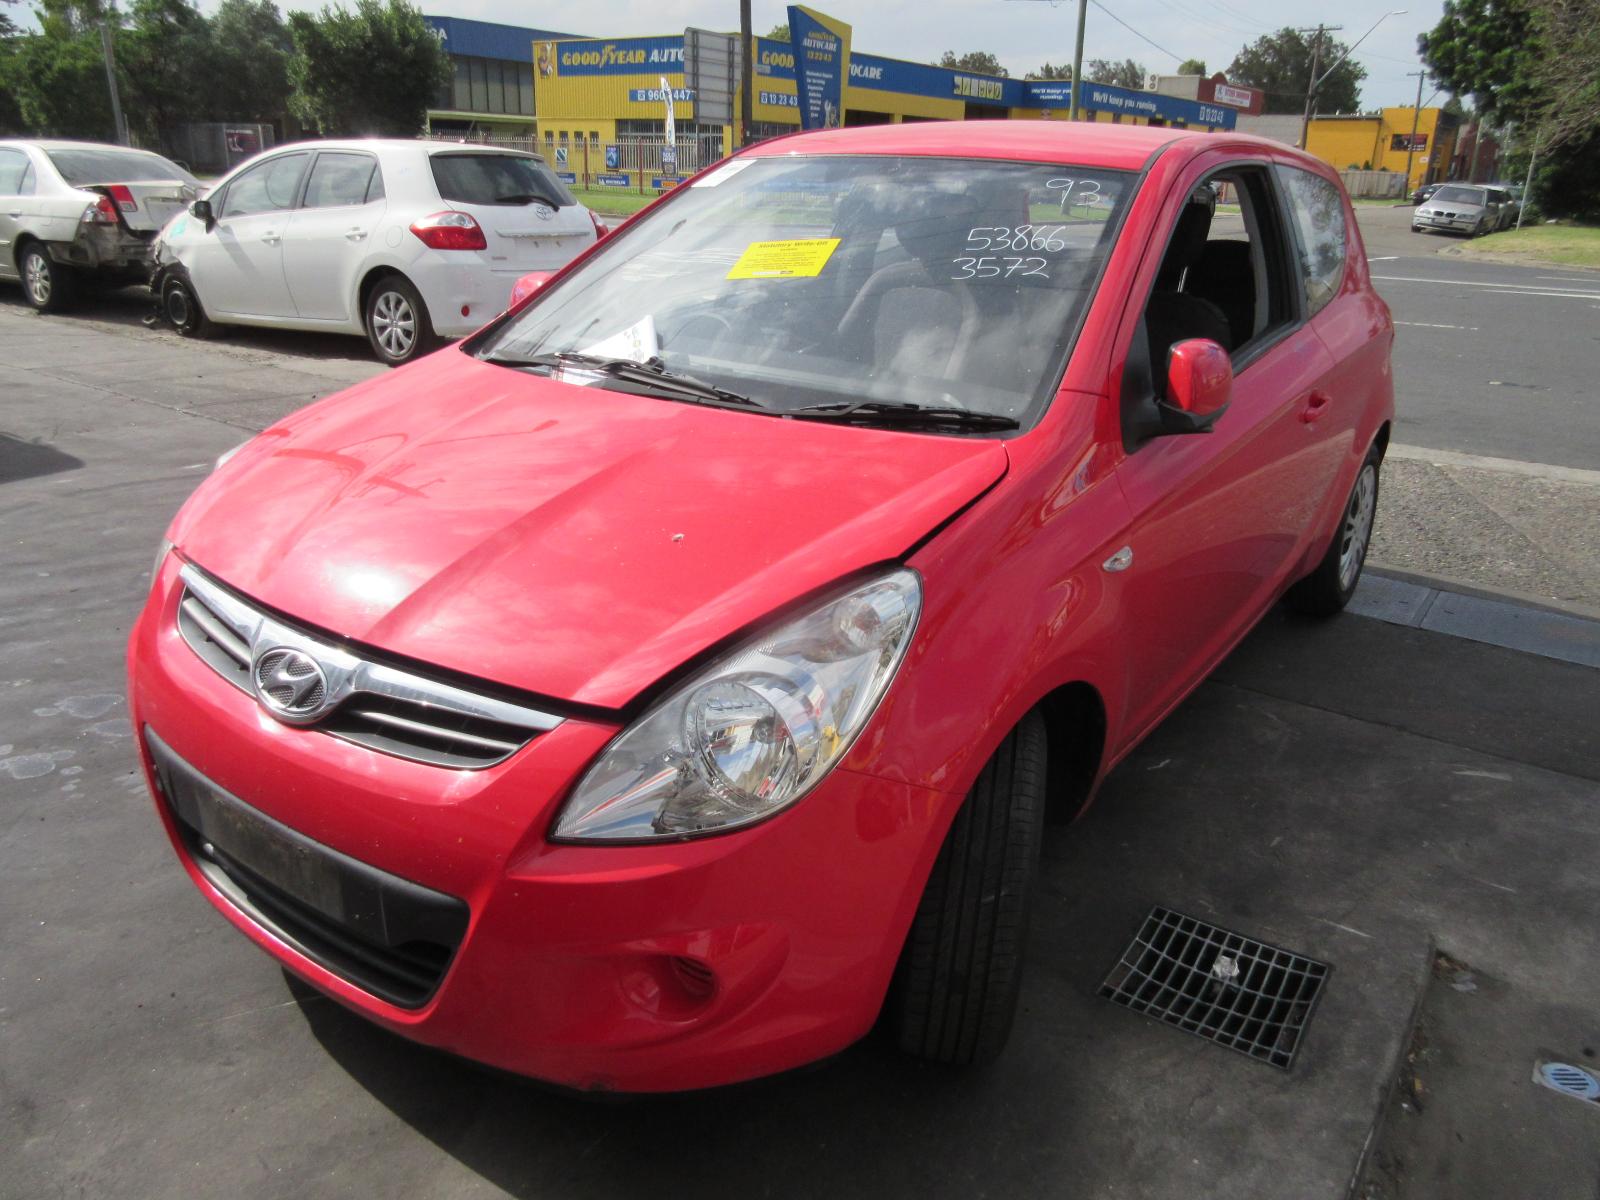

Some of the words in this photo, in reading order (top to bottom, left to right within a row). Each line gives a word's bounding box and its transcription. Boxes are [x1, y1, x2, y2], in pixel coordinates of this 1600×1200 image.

[562, 45, 646, 67] GOODYEAR
[802, 38, 837, 52] AUTOCARE
[769, 94, 777, 105] 13
[778, 95, 787, 106] 23
[789, 96, 798, 106] 43
[1093, 91, 1108, 104] We'll
[1109, 95, 1123, 108] keep
[1124, 98, 1135, 109] you
[1046, 178, 1101, 208] 93
[965, 224, 1067, 253] 53866
[951, 257, 1050, 280] 3572
